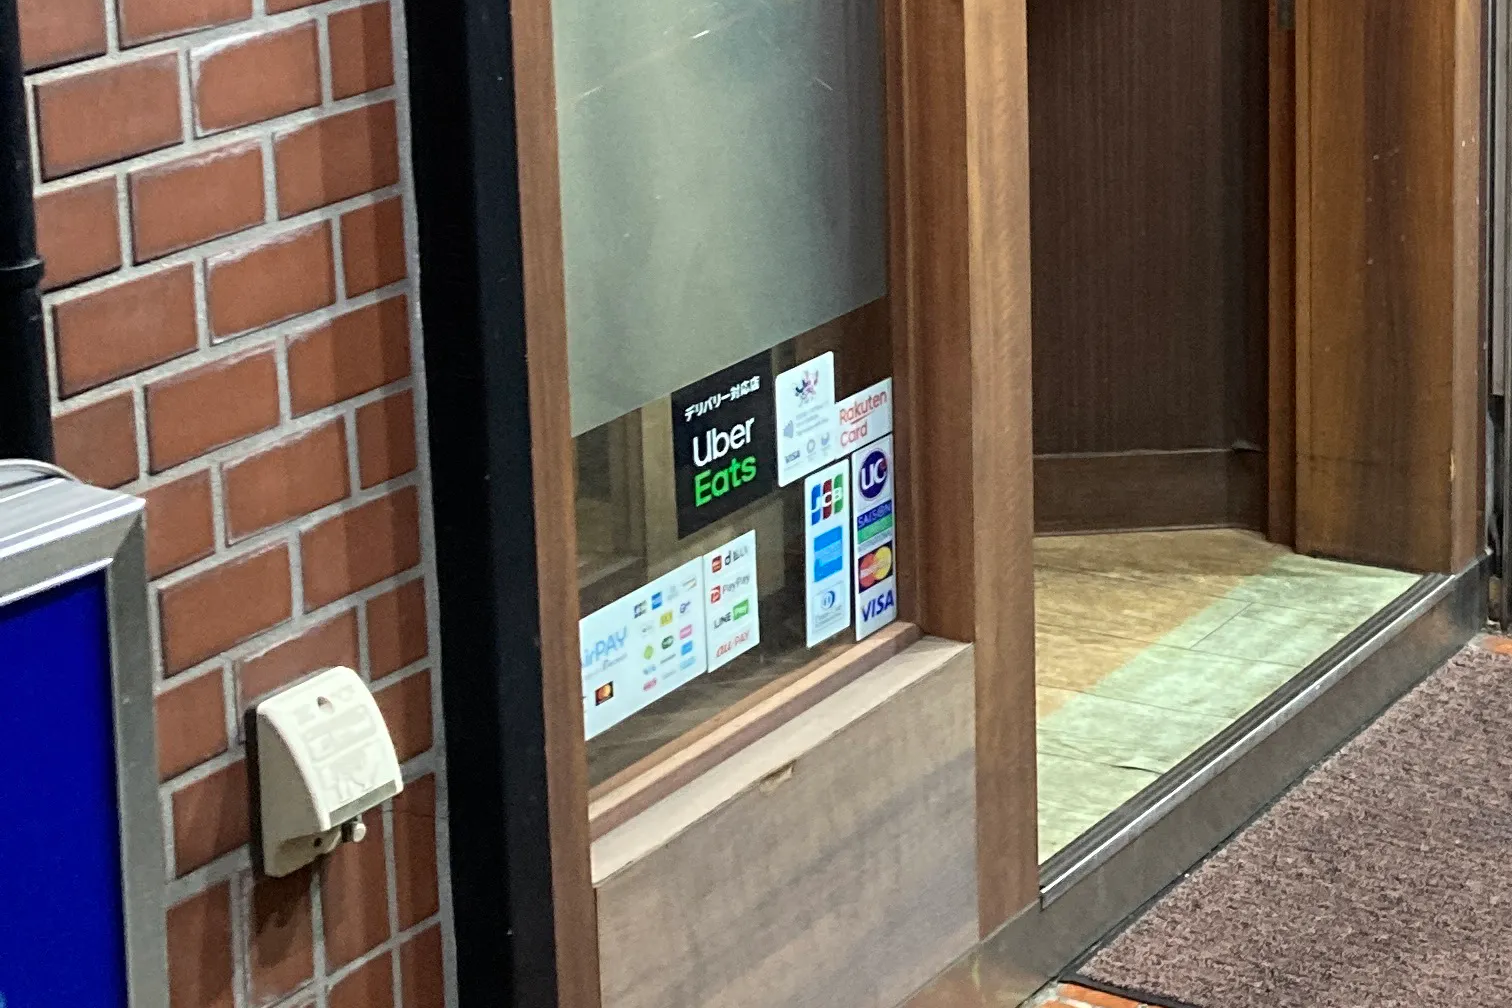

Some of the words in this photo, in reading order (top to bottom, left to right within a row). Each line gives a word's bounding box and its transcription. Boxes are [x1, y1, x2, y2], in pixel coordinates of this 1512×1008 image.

[685, 375, 761, 422] デリバリー対応店
[839, 390, 888, 425] Rakuten
[692, 416, 755, 467] Uber
[840, 422, 868, 447] Card
[694, 454, 757, 507] Eats
[861, 456, 887, 490] UC
[811, 480, 843, 518] JCB
[858, 503, 892, 529] SAISON
[861, 592, 895, 622] VISA
[582, 625, 628, 667] irPAY
